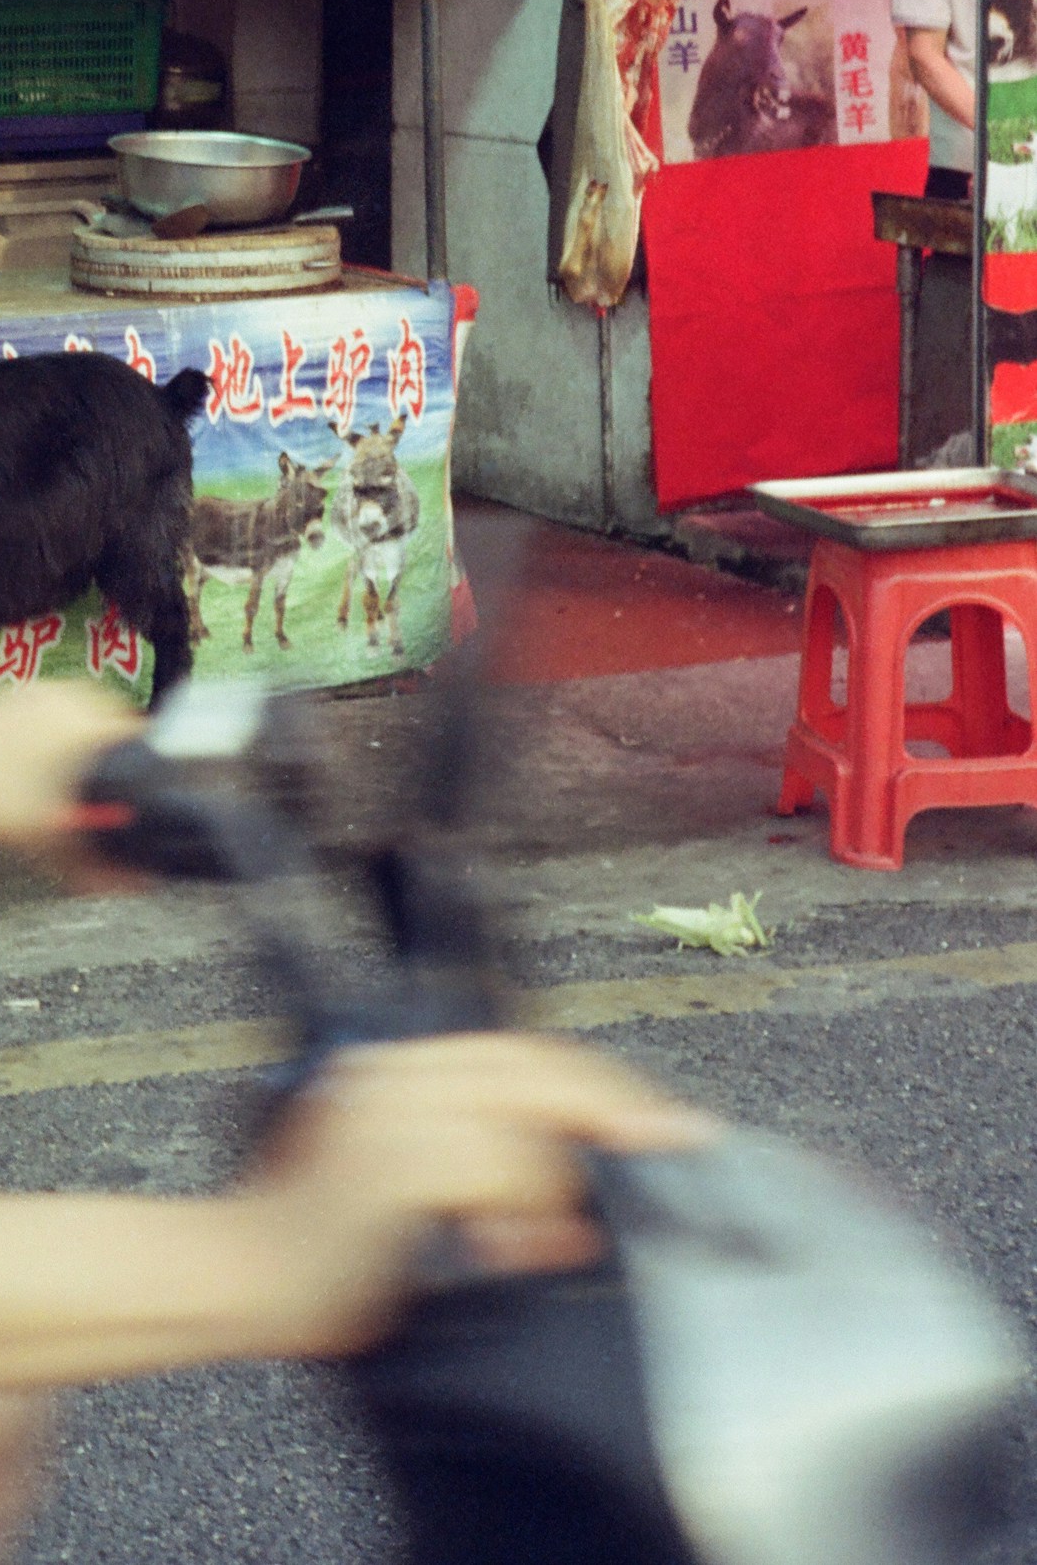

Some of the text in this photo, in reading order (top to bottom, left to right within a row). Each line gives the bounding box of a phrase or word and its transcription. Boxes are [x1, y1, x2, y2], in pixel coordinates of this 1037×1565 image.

[839, 31, 876, 135] 黄毛羊
[207, 317, 428, 435] 地上驴肉
